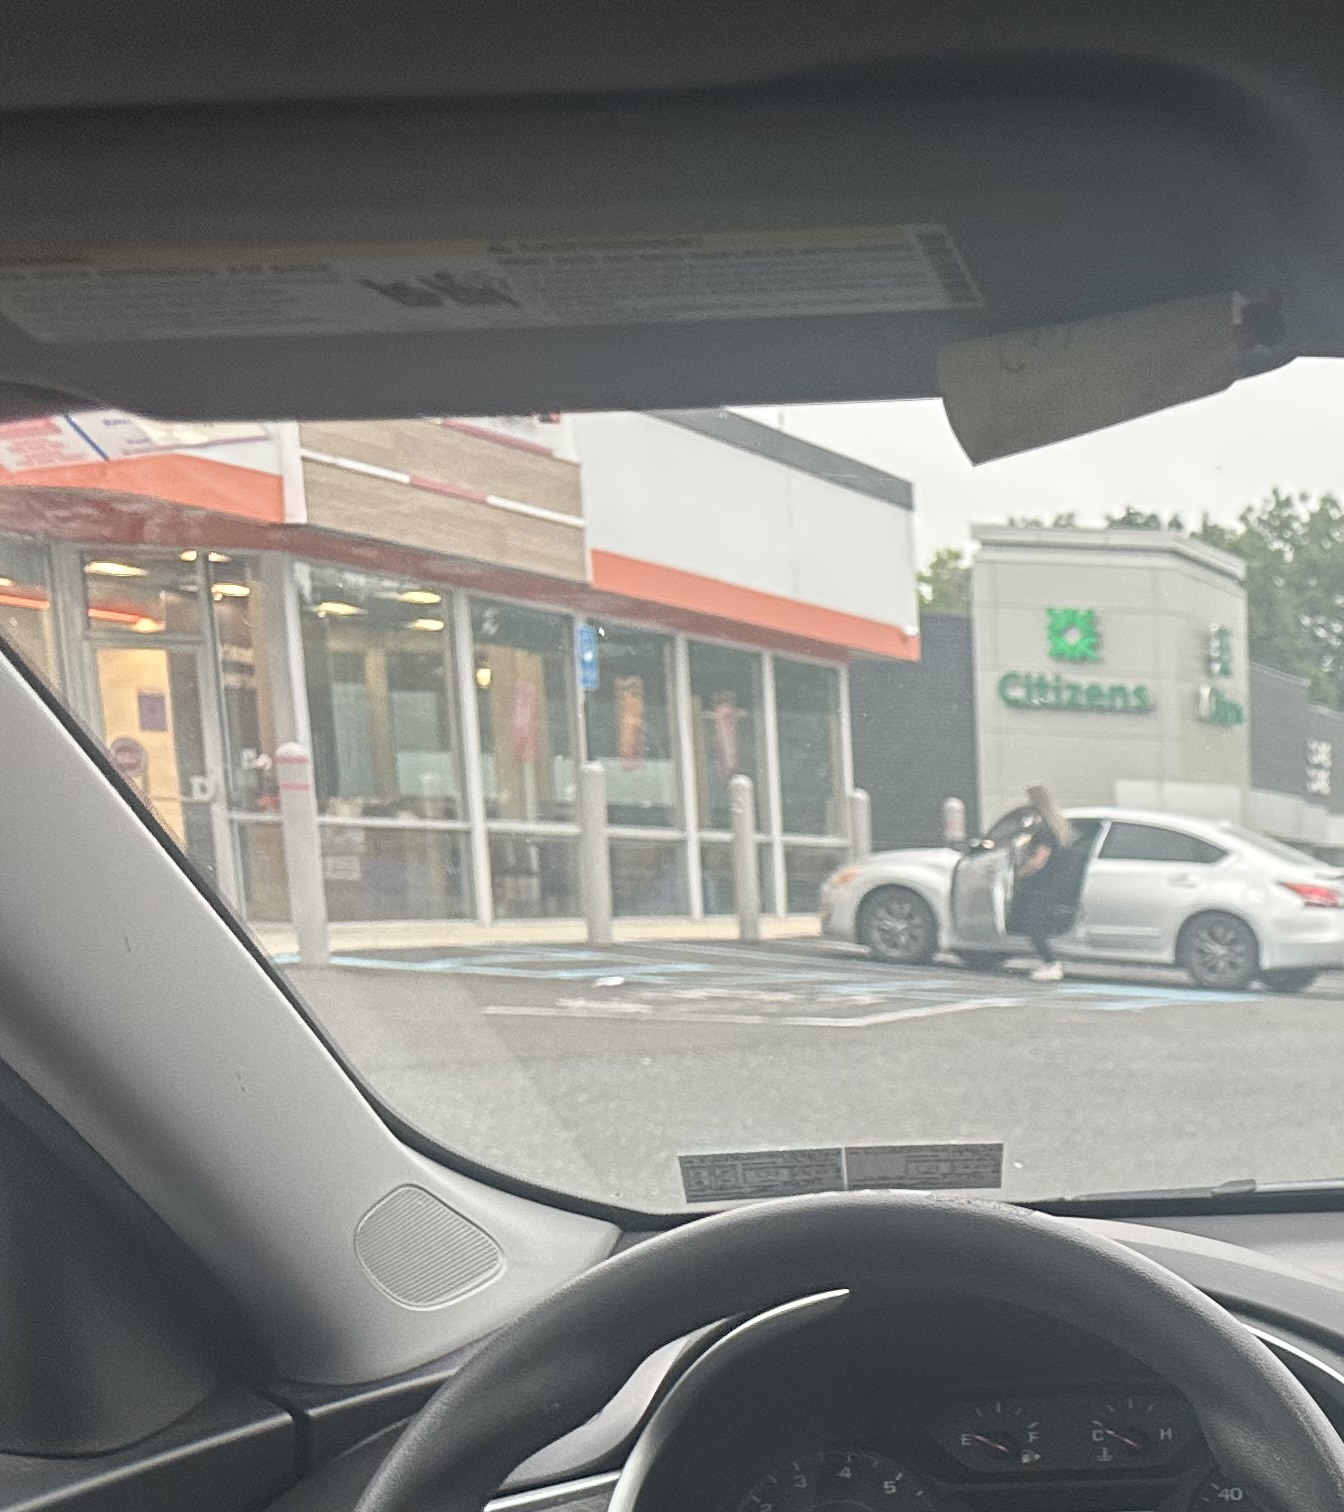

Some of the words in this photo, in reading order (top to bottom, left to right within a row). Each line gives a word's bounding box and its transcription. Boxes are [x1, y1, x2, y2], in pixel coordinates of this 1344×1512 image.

[998, 671, 1152, 711] Citizens
[960, 1433, 973, 1446] E
[1028, 1431, 1039, 1442] F
[1092, 1429, 1104, 1442] C
[1160, 1428, 1172, 1440] H
[836, 1467, 851, 1479] 4
[794, 1475, 807, 1488] 3
[883, 1481, 896, 1494] 5
[1217, 1487, 1243, 1501] 40
